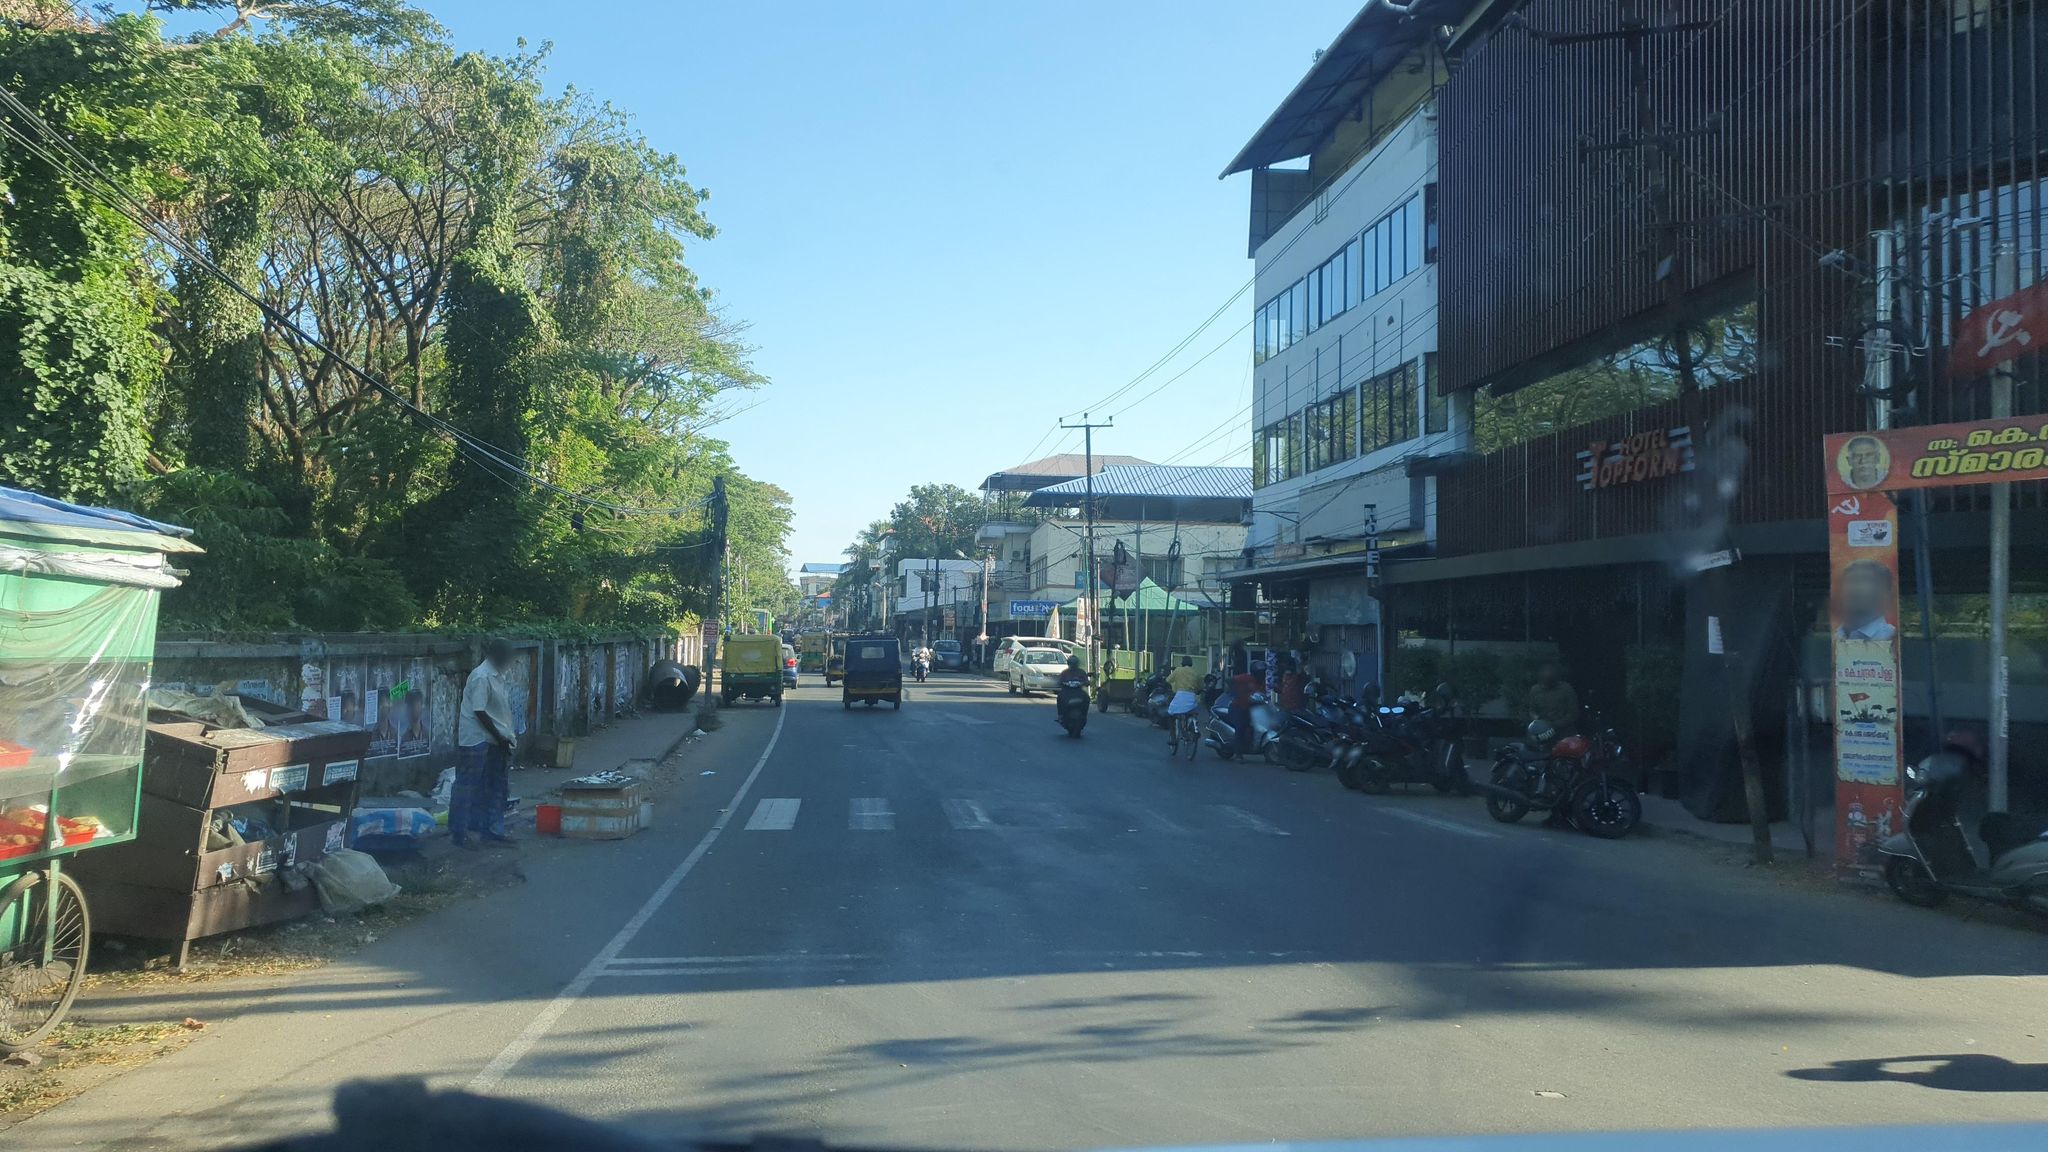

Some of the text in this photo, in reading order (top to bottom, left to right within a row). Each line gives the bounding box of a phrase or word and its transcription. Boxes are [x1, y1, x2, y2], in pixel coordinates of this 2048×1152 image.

[1621, 428, 1667, 456] HOTEL
[1589, 441, 1681, 488] TOPFORM
[1912, 448, 2048, 478] സ്മാര
